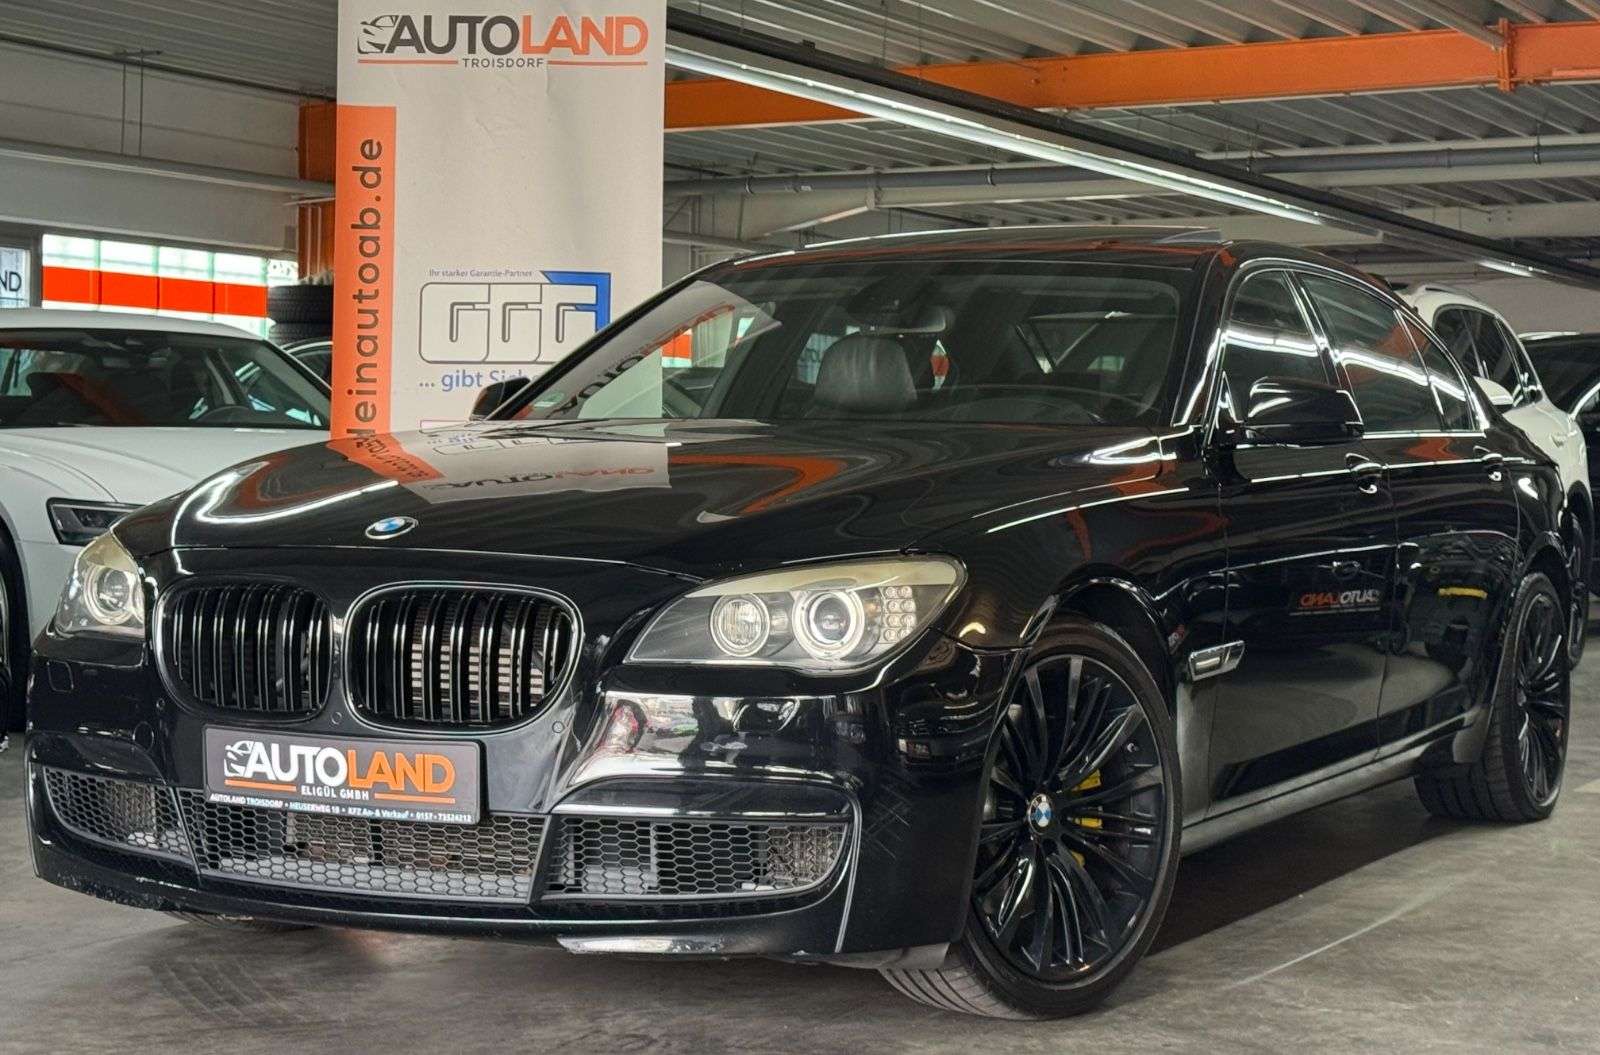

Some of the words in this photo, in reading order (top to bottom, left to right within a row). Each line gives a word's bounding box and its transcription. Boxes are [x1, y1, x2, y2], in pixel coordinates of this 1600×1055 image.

[385, 15, 649, 55] AUTOLAND
[463, 57, 544, 68] TROISDORF
[346, 138, 382, 435] einautoab.de
[441, 370, 483, 392] gibt
[244, 741, 456, 793] AUTOLAND
[210, 793, 246, 804] AUTOLAND
[301, 785, 336, 798] ELIGÜL
[339, 789, 369, 800] GMBH
